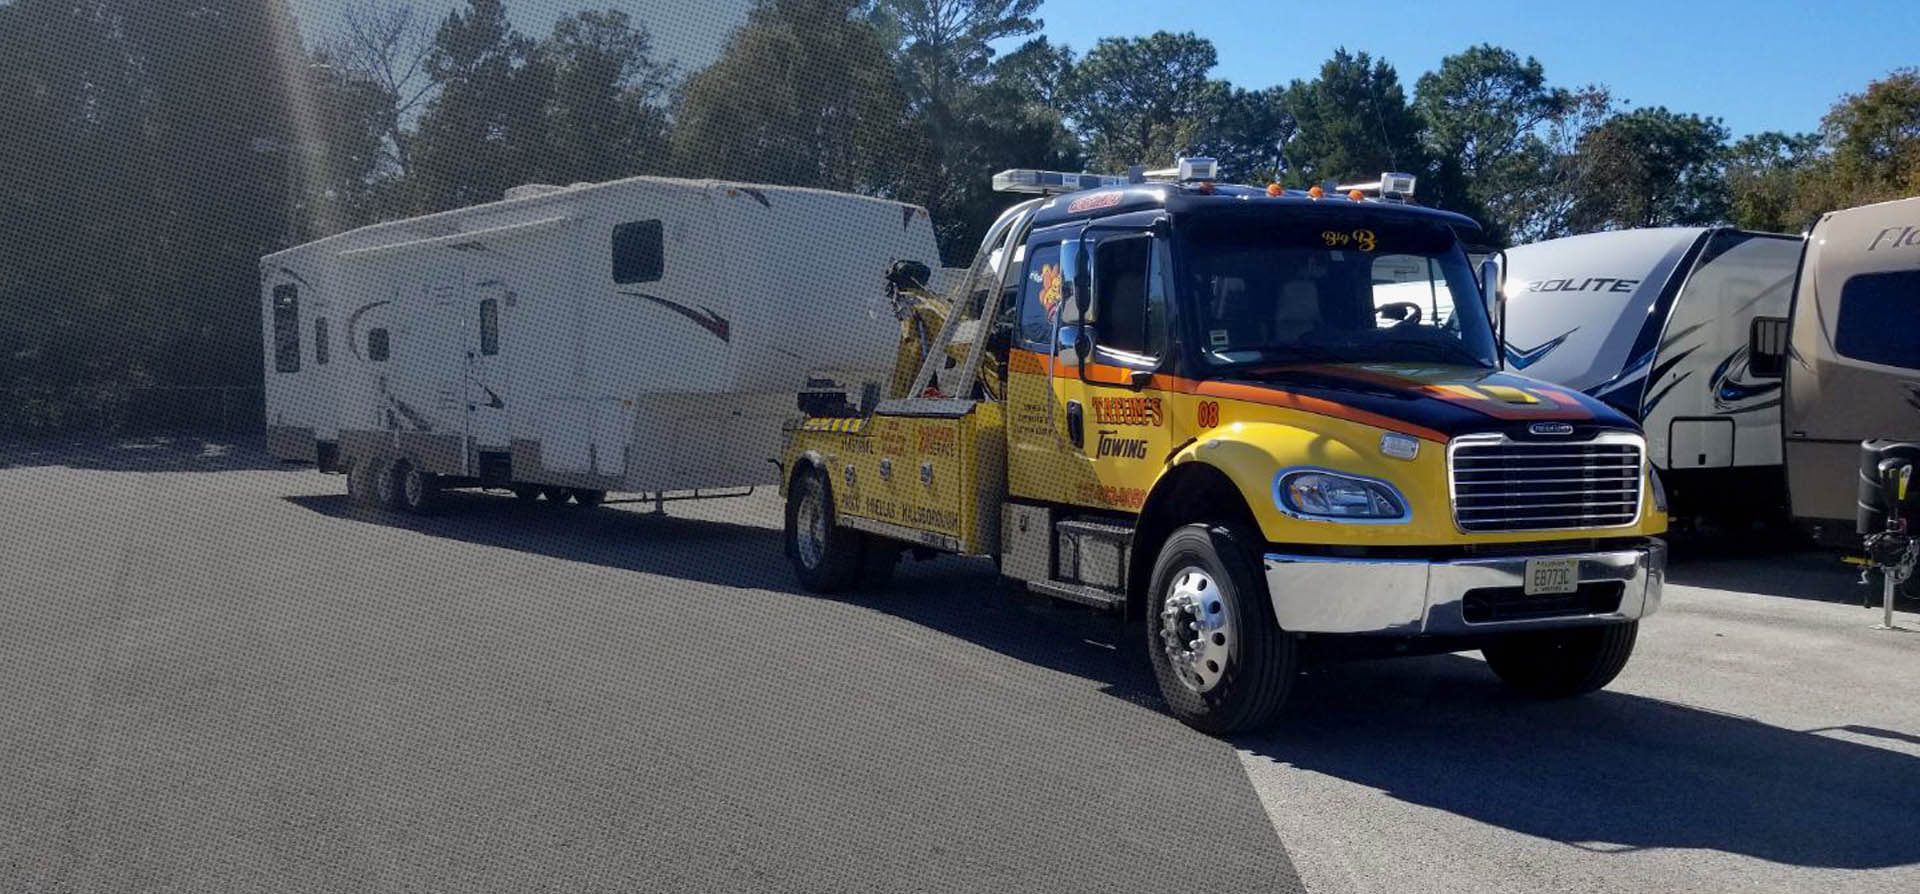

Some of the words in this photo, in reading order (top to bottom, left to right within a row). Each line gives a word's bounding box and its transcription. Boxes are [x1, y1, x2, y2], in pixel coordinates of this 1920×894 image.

[1322, 231, 1349, 246] Big
[1352, 228, 1376, 251] B
[1197, 401, 1220, 428] 08
